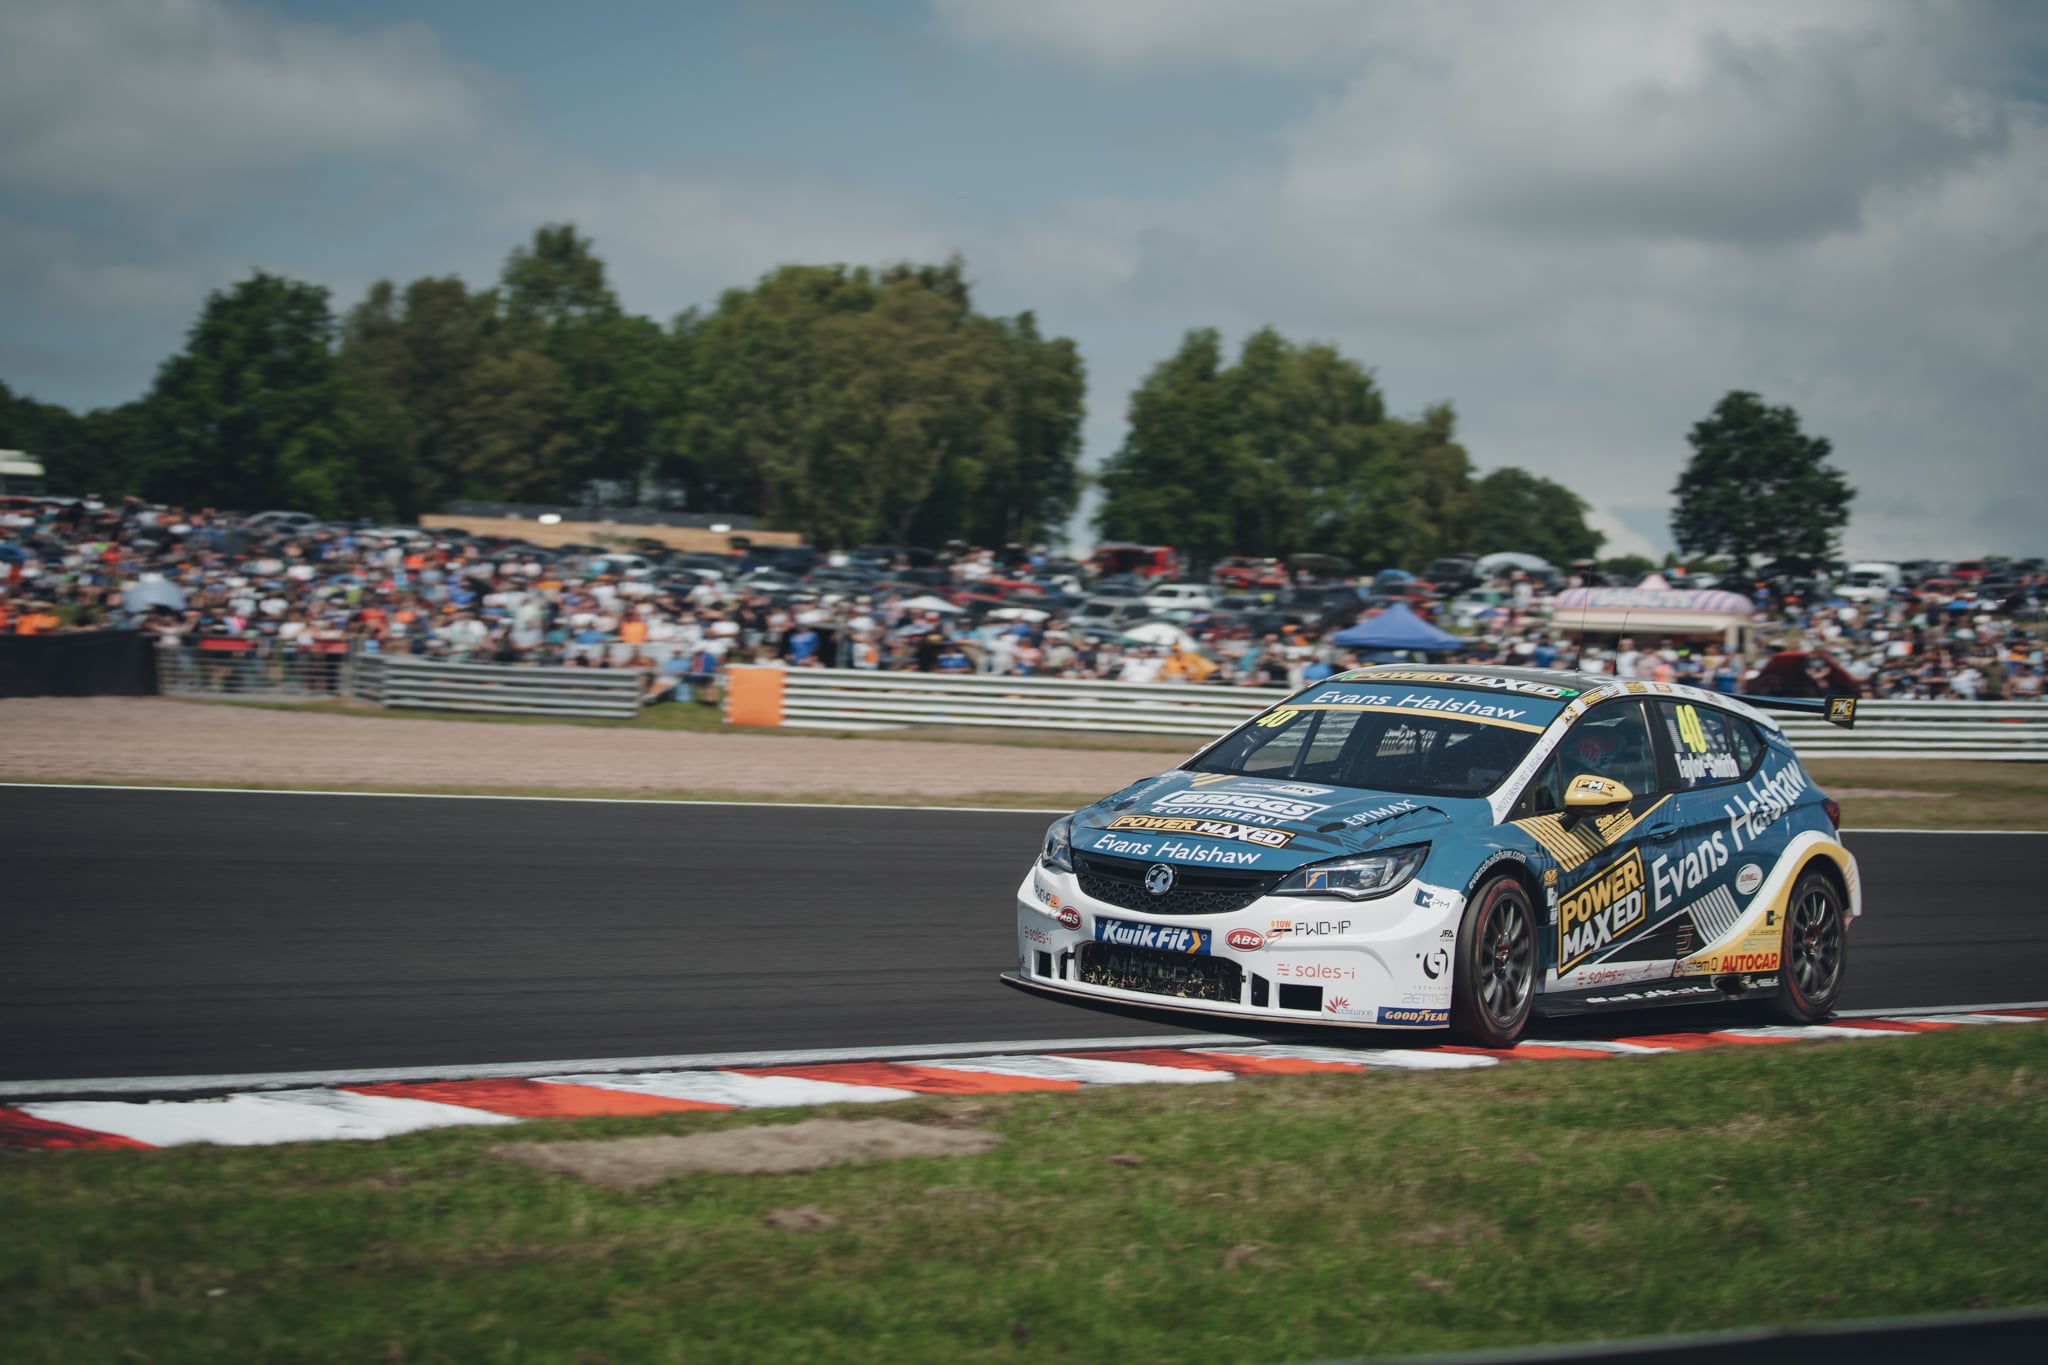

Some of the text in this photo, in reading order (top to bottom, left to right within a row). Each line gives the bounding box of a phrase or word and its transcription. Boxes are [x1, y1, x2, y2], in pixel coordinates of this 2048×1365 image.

[1450, 675, 1561, 694] MAXED
[1312, 691, 1527, 719] Evans Halshaw
[1256, 710, 1299, 728] 40
[1675, 704, 1707, 753] 40
[1674, 753, 1740, 787] Taylor-Smith
[1150, 806, 1288, 826] EQUIPMENT
[1169, 794, 1309, 816] BRIGGS
[1342, 799, 1418, 826] EPIMAX
[1115, 817, 1285, 845] POWER MAXED
[1652, 830, 1728, 912] Evans
[1724, 759, 1807, 851] Halshaw
[1093, 834, 1262, 865] Evans Halshaw
[1469, 849, 1526, 889] evanshalshaw.com
[1561, 860, 1640, 933] POWER
[1060, 911, 1079, 924] ABS
[1276, 920, 1291, 929] TOW
[1295, 921, 1351, 936] FWD-IP
[1562, 890, 1643, 964] MAXED
[1231, 935, 1260, 946] ABS
[1295, 964, 1355, 979] sales-i
[1720, 953, 1779, 972] AUTOCAR
[1385, 1010, 1449, 1022] GOODYEAR
